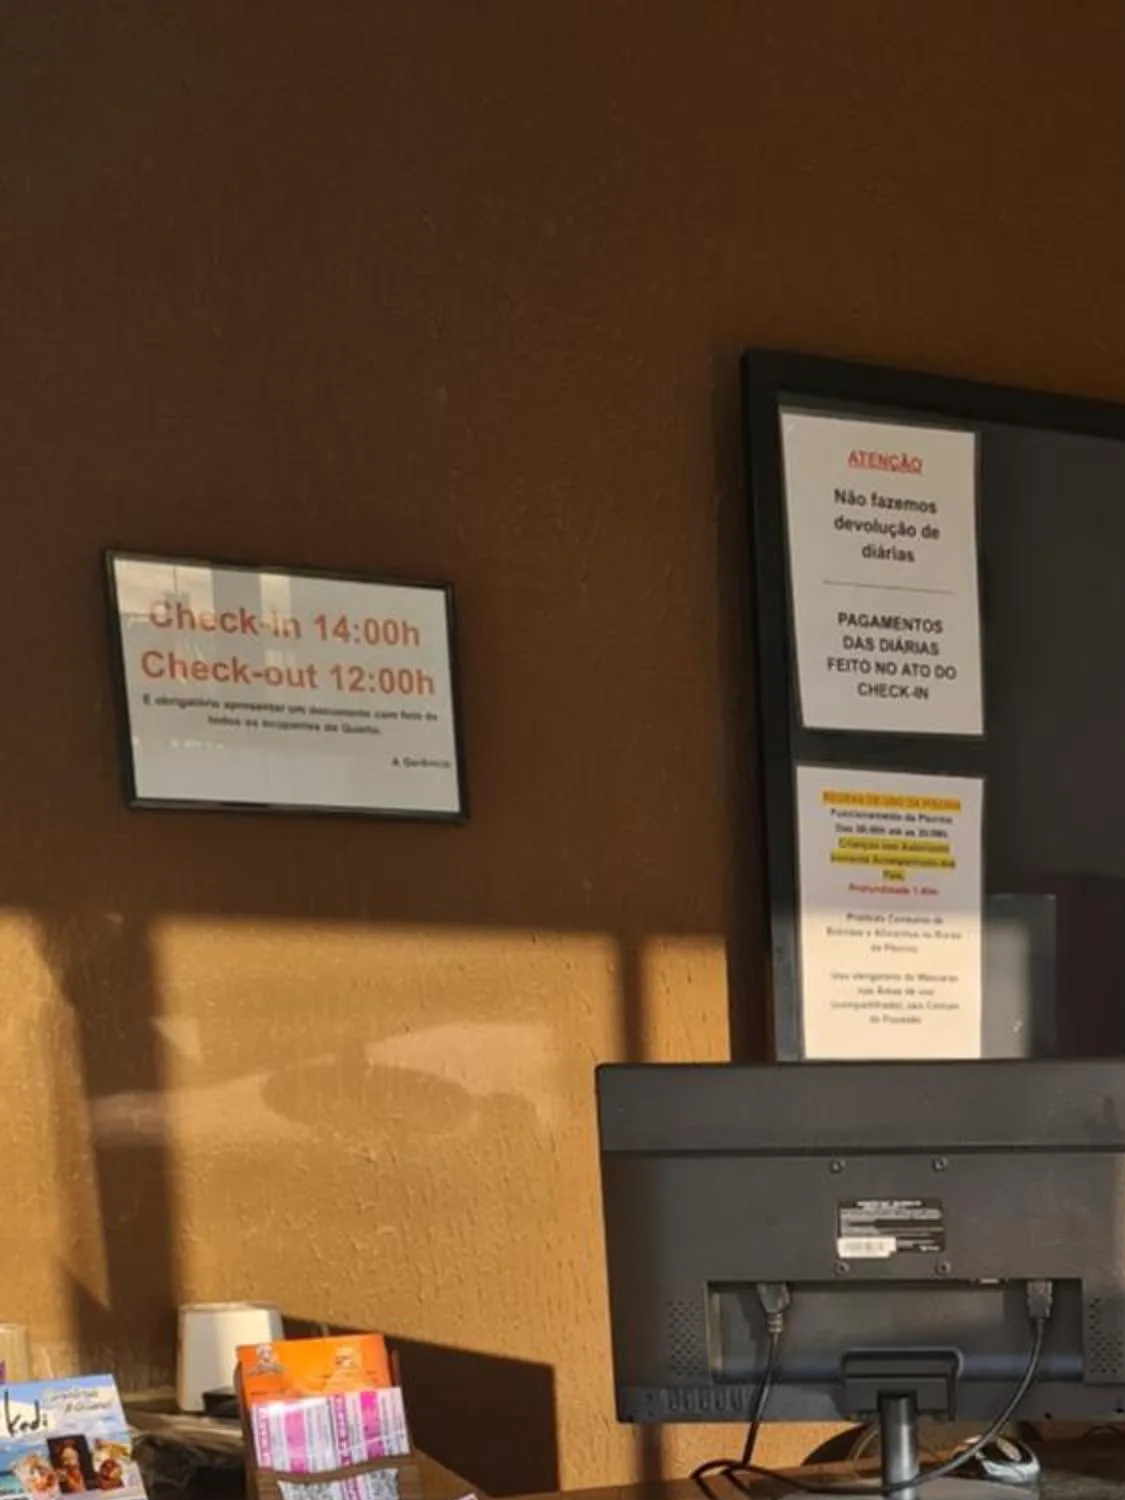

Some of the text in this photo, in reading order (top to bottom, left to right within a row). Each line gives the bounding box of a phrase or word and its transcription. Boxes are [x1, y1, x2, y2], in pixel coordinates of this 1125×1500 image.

[848, 449, 923, 473] ATENÇÃO
[834, 488, 937, 514] Não fazemos
[834, 517, 940, 540] devolução de
[862, 542, 915, 563] diárias
[149, 600, 420, 647] Check-in 14:00h
[838, 612, 943, 633] PAGAMENTOS
[843, 635, 939, 655] DAS DIÁRIAS
[141, 650, 435, 696] Check-out 12:00h
[827, 657, 957, 681] FEITO NO ATO DO
[857, 682, 929, 700] CHECK-IN
